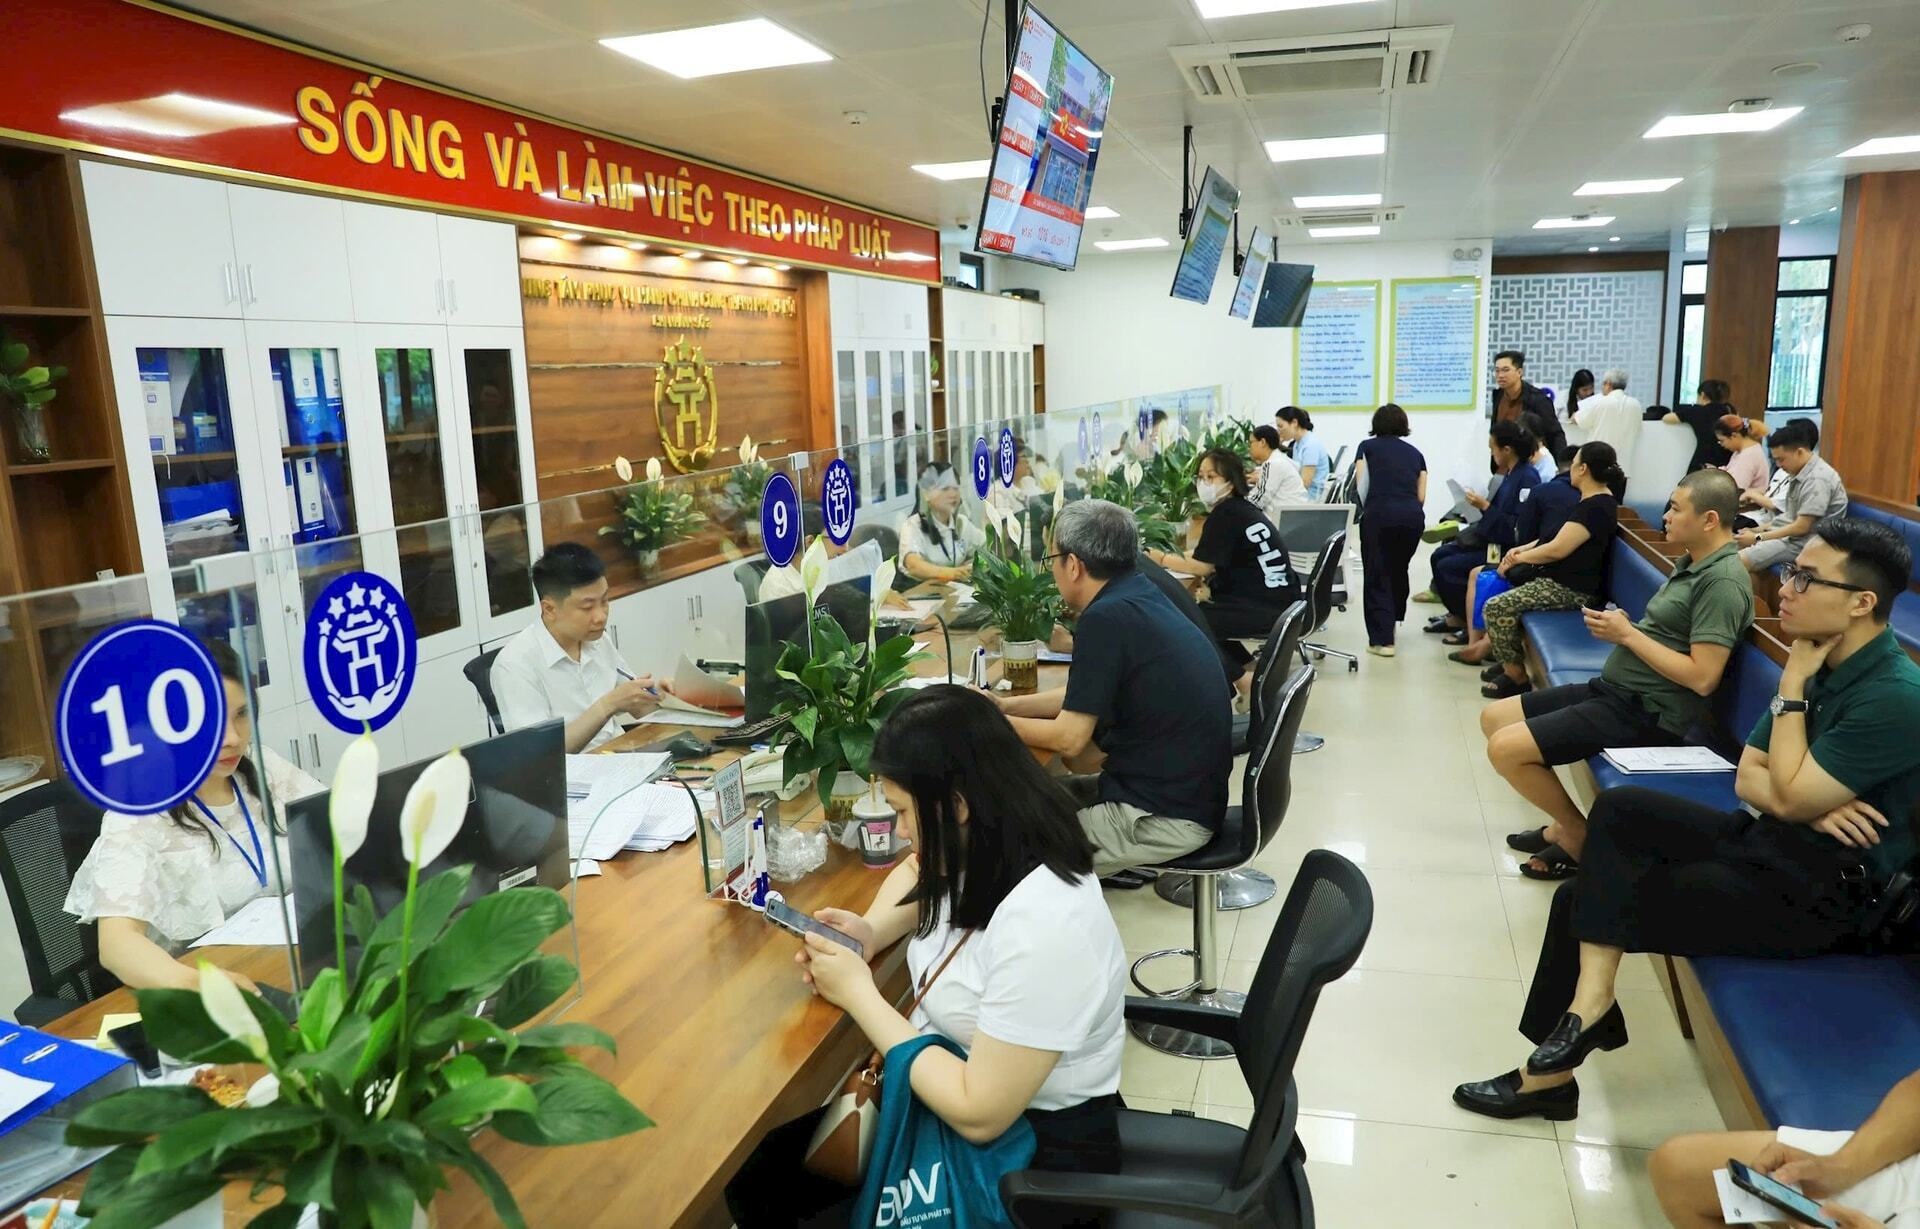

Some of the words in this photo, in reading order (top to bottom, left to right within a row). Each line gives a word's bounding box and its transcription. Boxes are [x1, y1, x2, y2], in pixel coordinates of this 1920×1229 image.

[297, 76, 466, 180] SỐNG
[484, 122, 544, 194] VÀ
[557, 140, 634, 213] LÀM
[644, 166, 714, 234] VIỆC
[723, 191, 785, 242] THEO
[792, 205, 844, 250] PHÁP
[849, 218, 892, 266] LUẬT
[977, 454, 986, 481] 8
[773, 500, 788, 539] 9
[90, 667, 206, 767] 10
